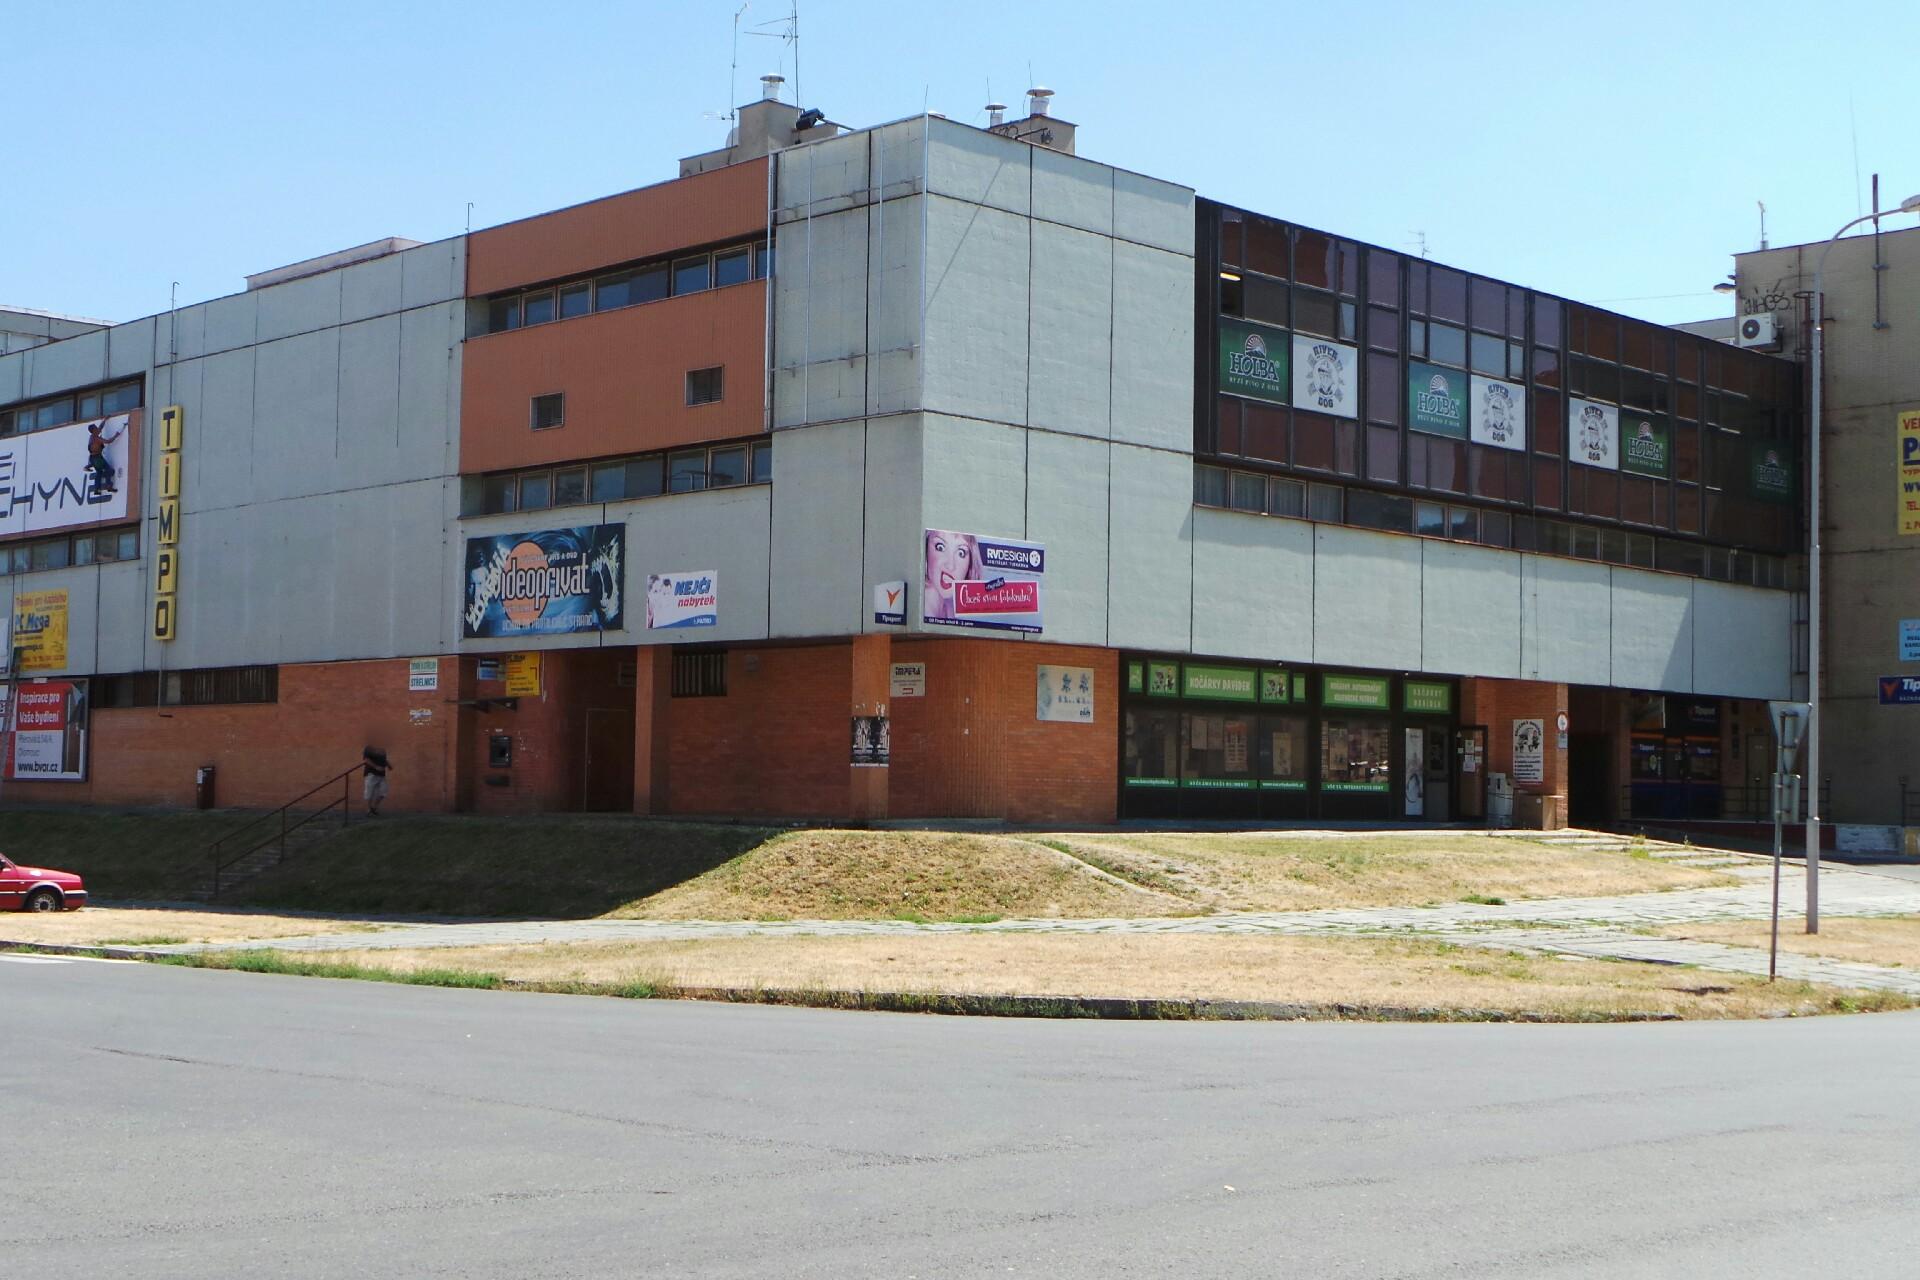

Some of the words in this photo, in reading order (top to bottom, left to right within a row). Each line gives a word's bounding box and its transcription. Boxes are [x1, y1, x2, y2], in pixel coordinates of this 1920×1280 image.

[1230, 352, 1280, 383] HOLBA
[1417, 391, 1459, 418] HOLBA
[987, 548, 1029, 563] RVDESIGN
